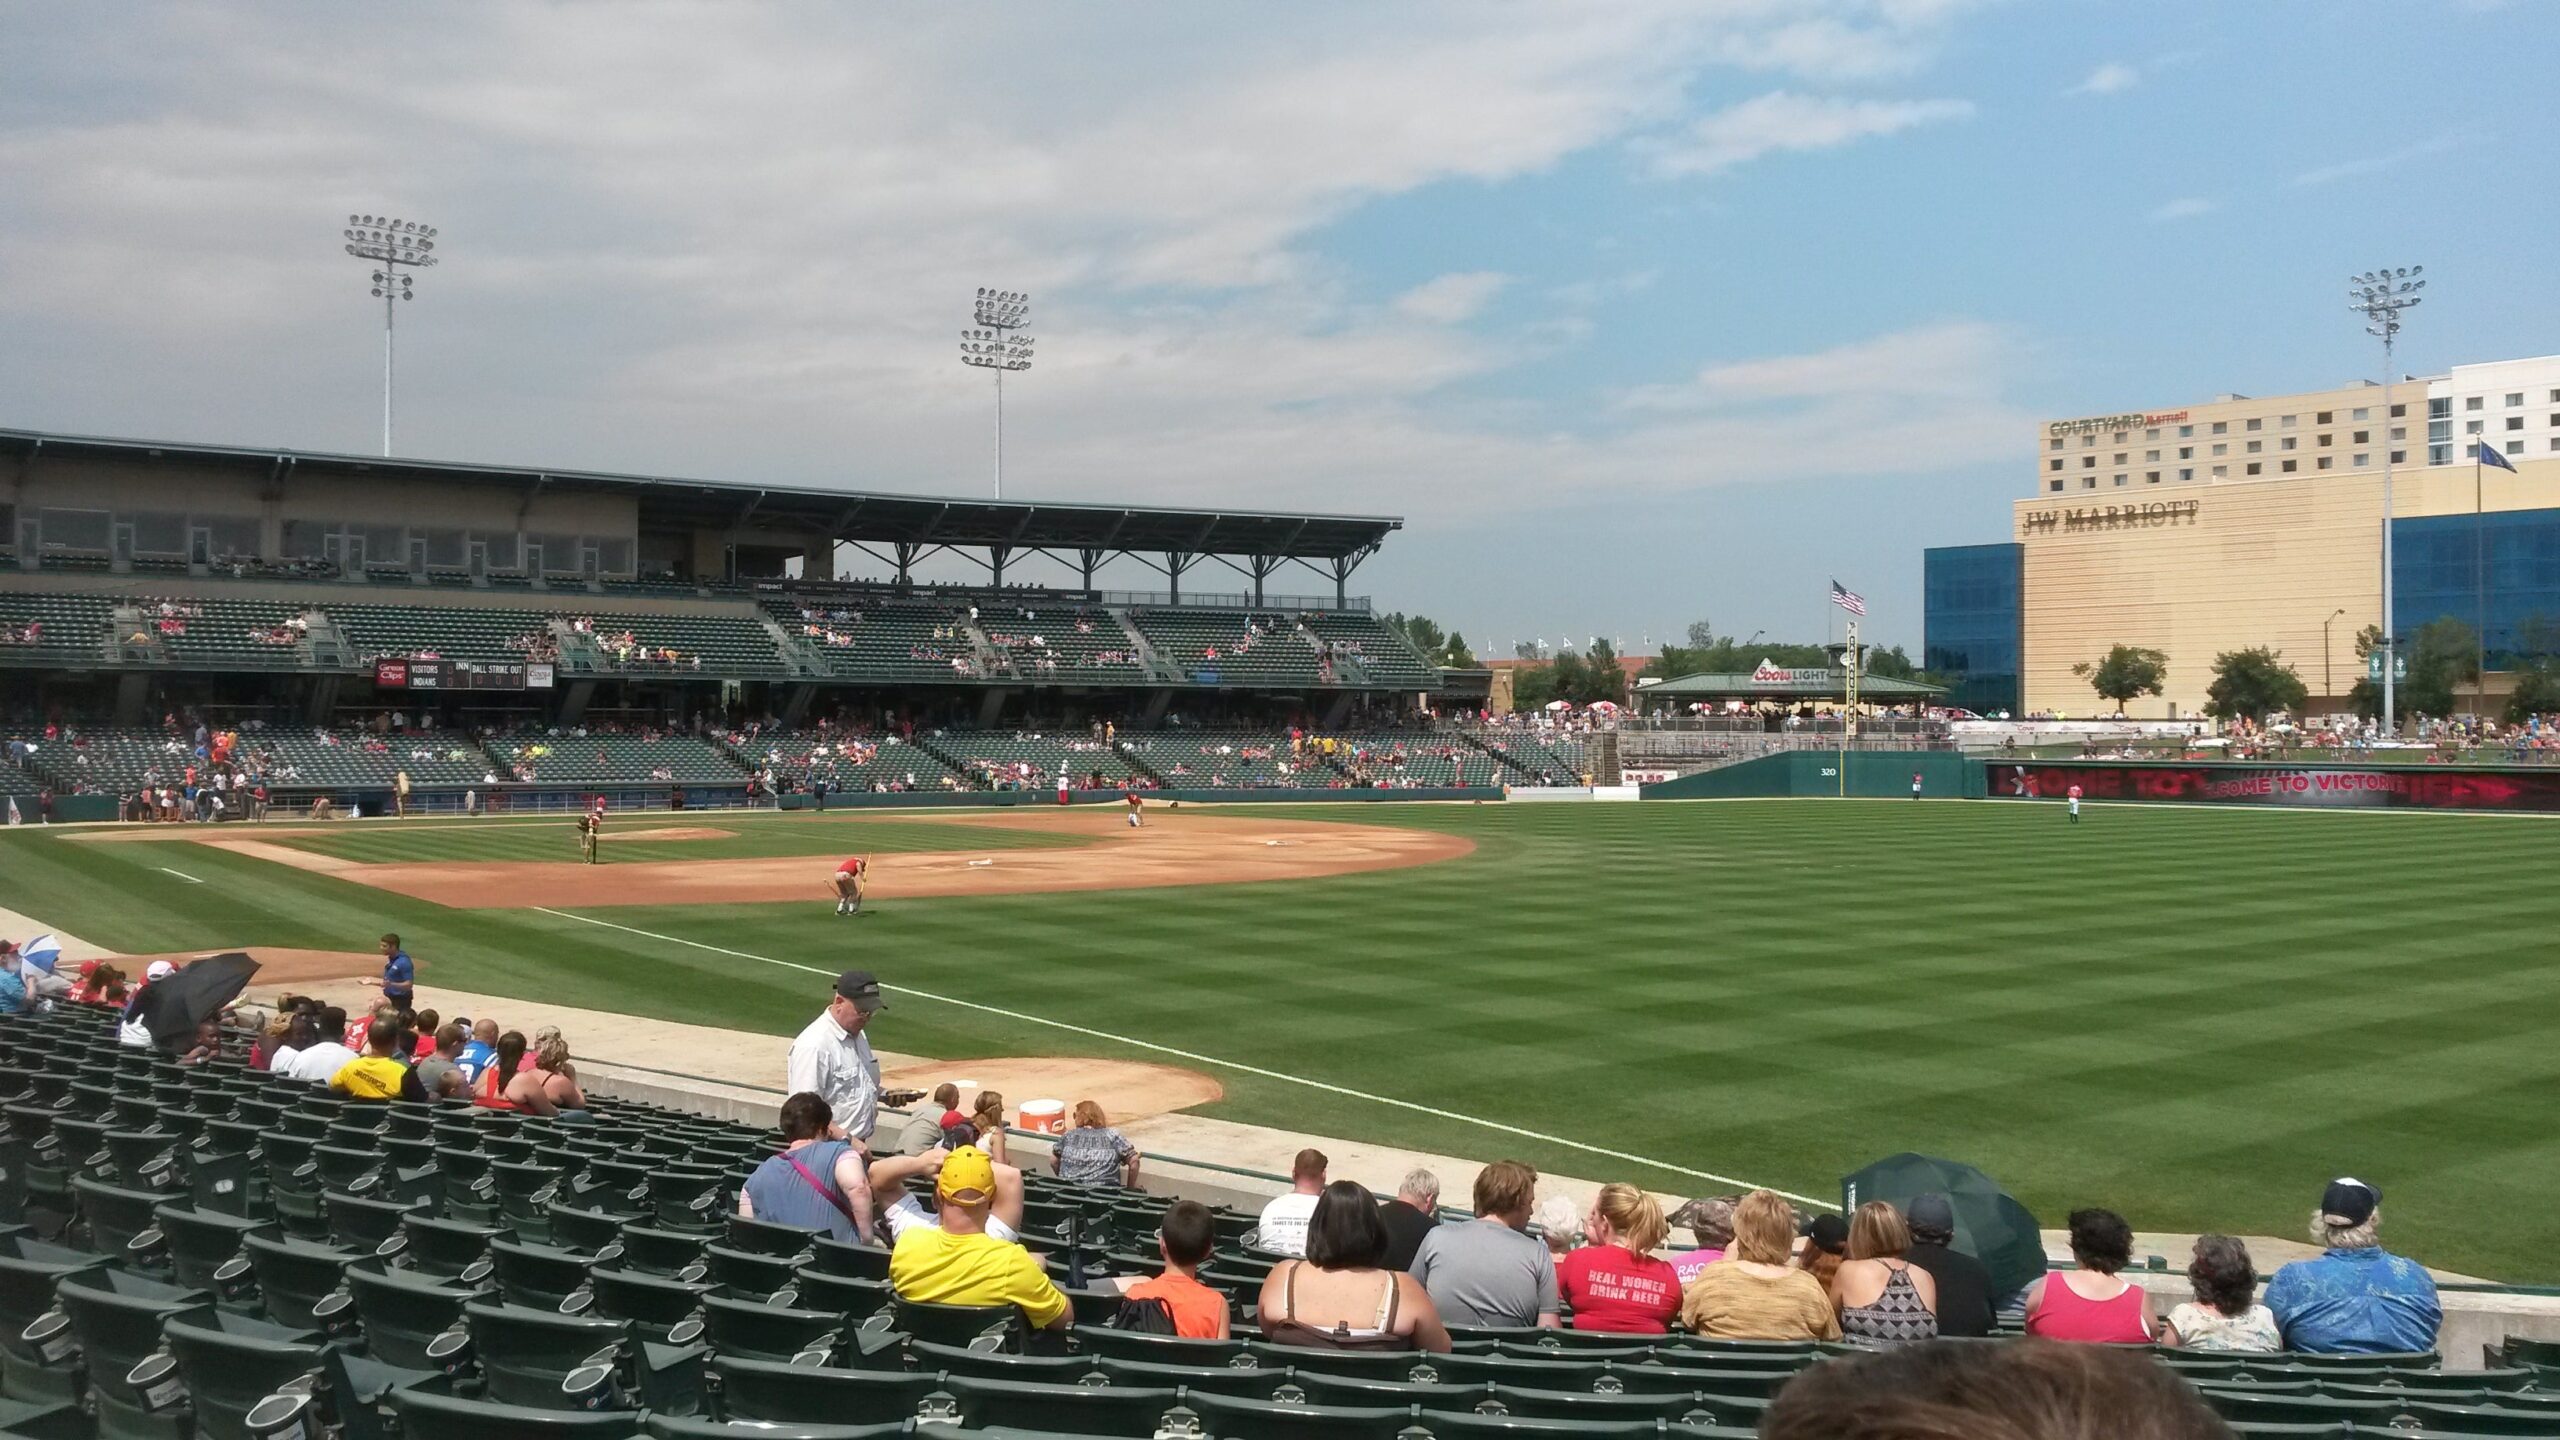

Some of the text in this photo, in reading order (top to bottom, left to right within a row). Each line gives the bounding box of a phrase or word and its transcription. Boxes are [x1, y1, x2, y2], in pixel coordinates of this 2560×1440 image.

[2049, 411, 2189, 435] COURTYARD Marriott
[2023, 500, 2199, 529] JW MARRIOTT
[378, 663, 405, 671] Great
[411, 664, 439, 674] VISITORS
[455, 661, 469, 671] INN
[472, 664, 522, 674] BALL STRIKE OUT
[380, 671, 405, 680] Clips
[1755, 666, 1825, 680] Coors LIGHT
[413, 677, 437, 686] INDIANS
[1820, 767, 1836, 777] 320
[2276, 775, 2309, 793] TO
[1677, 1263, 1706, 1276] RAC
[1588, 1269, 1666, 1294] REAL WOMEN
[1589, 1283, 1661, 1305] DRINK BEER
